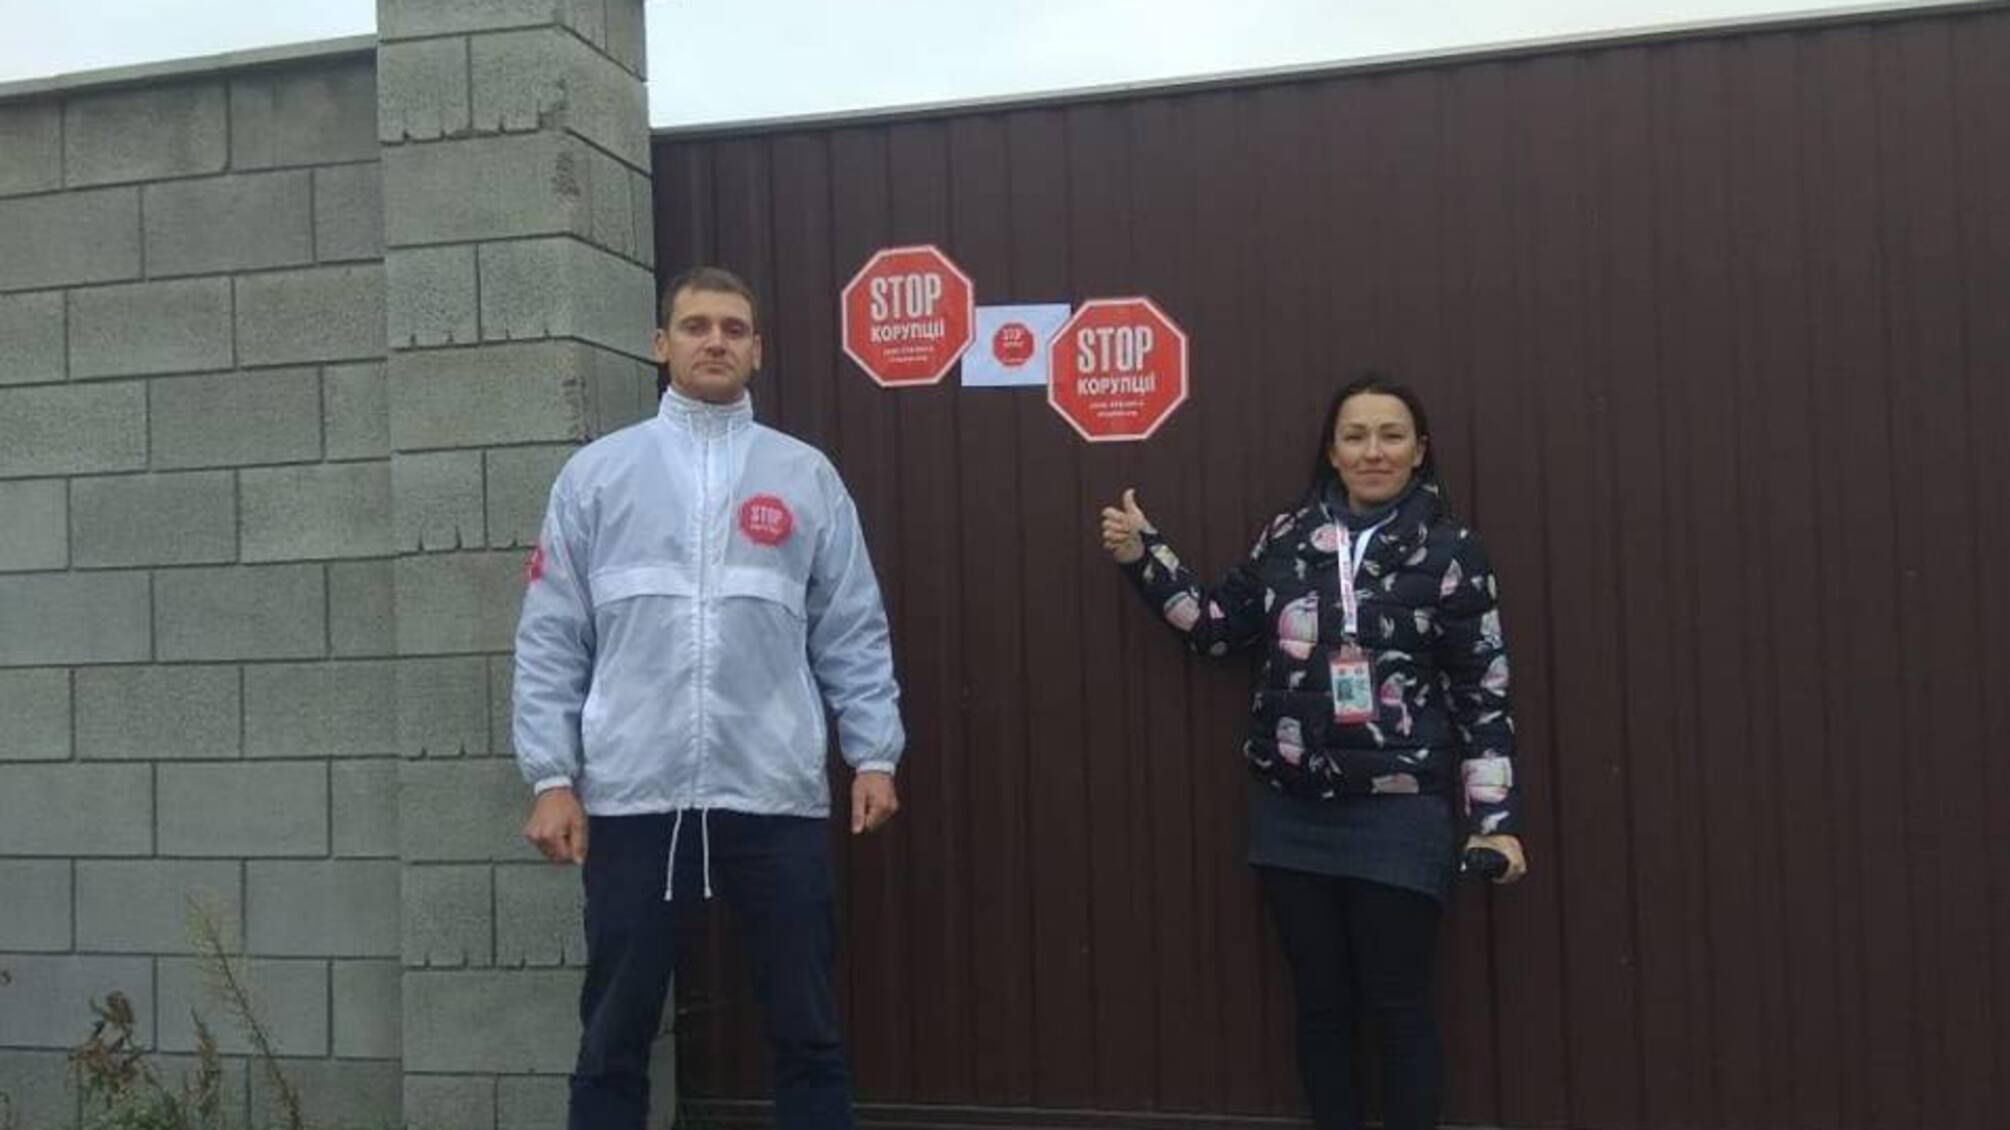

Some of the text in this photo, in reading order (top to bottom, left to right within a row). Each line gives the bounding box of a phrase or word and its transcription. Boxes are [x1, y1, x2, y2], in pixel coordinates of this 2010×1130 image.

[870, 272, 942, 321] STOP
[1077, 325, 1154, 374] STOP
[1077, 372, 1156, 396] КОРУПЦІЇ
